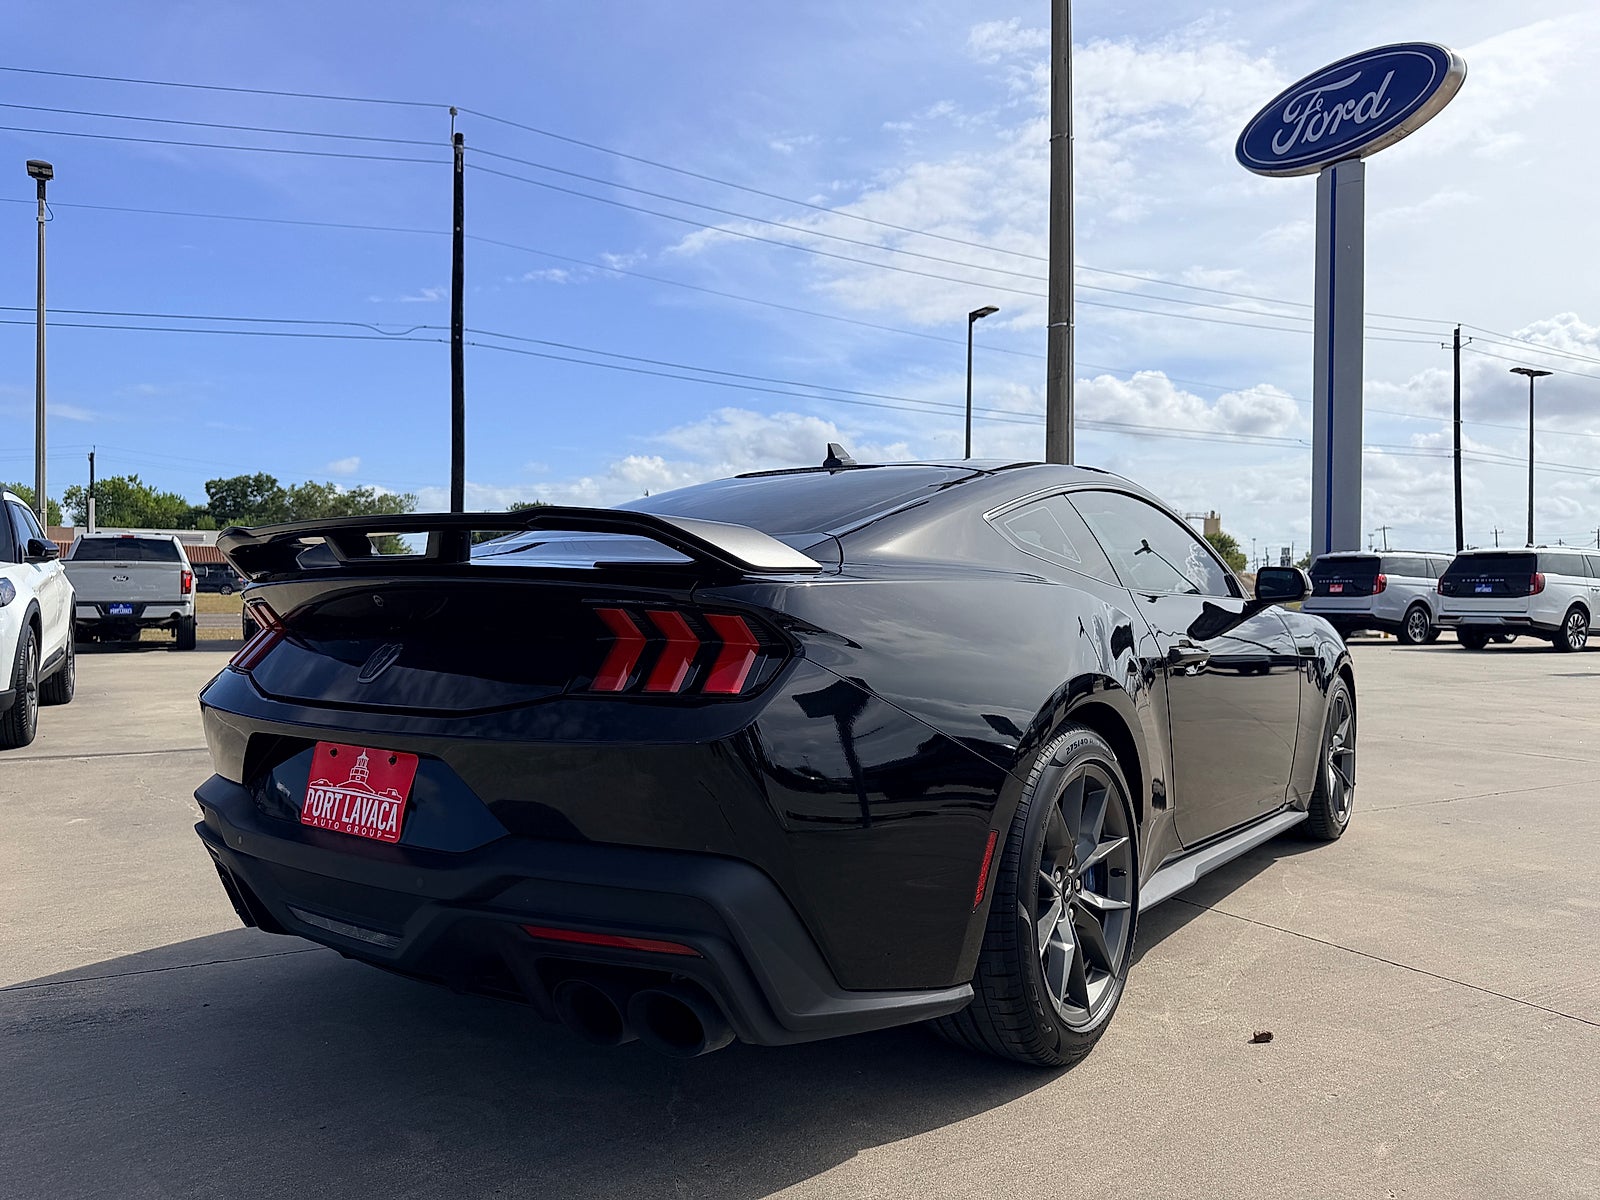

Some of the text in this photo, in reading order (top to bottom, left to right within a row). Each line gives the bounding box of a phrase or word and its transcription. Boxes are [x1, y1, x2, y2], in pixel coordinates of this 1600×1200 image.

[1271, 70, 1395, 155] Ford
[303, 788, 398, 832] PORT LAVACA
[312, 817, 382, 838] AUTO GROUP
